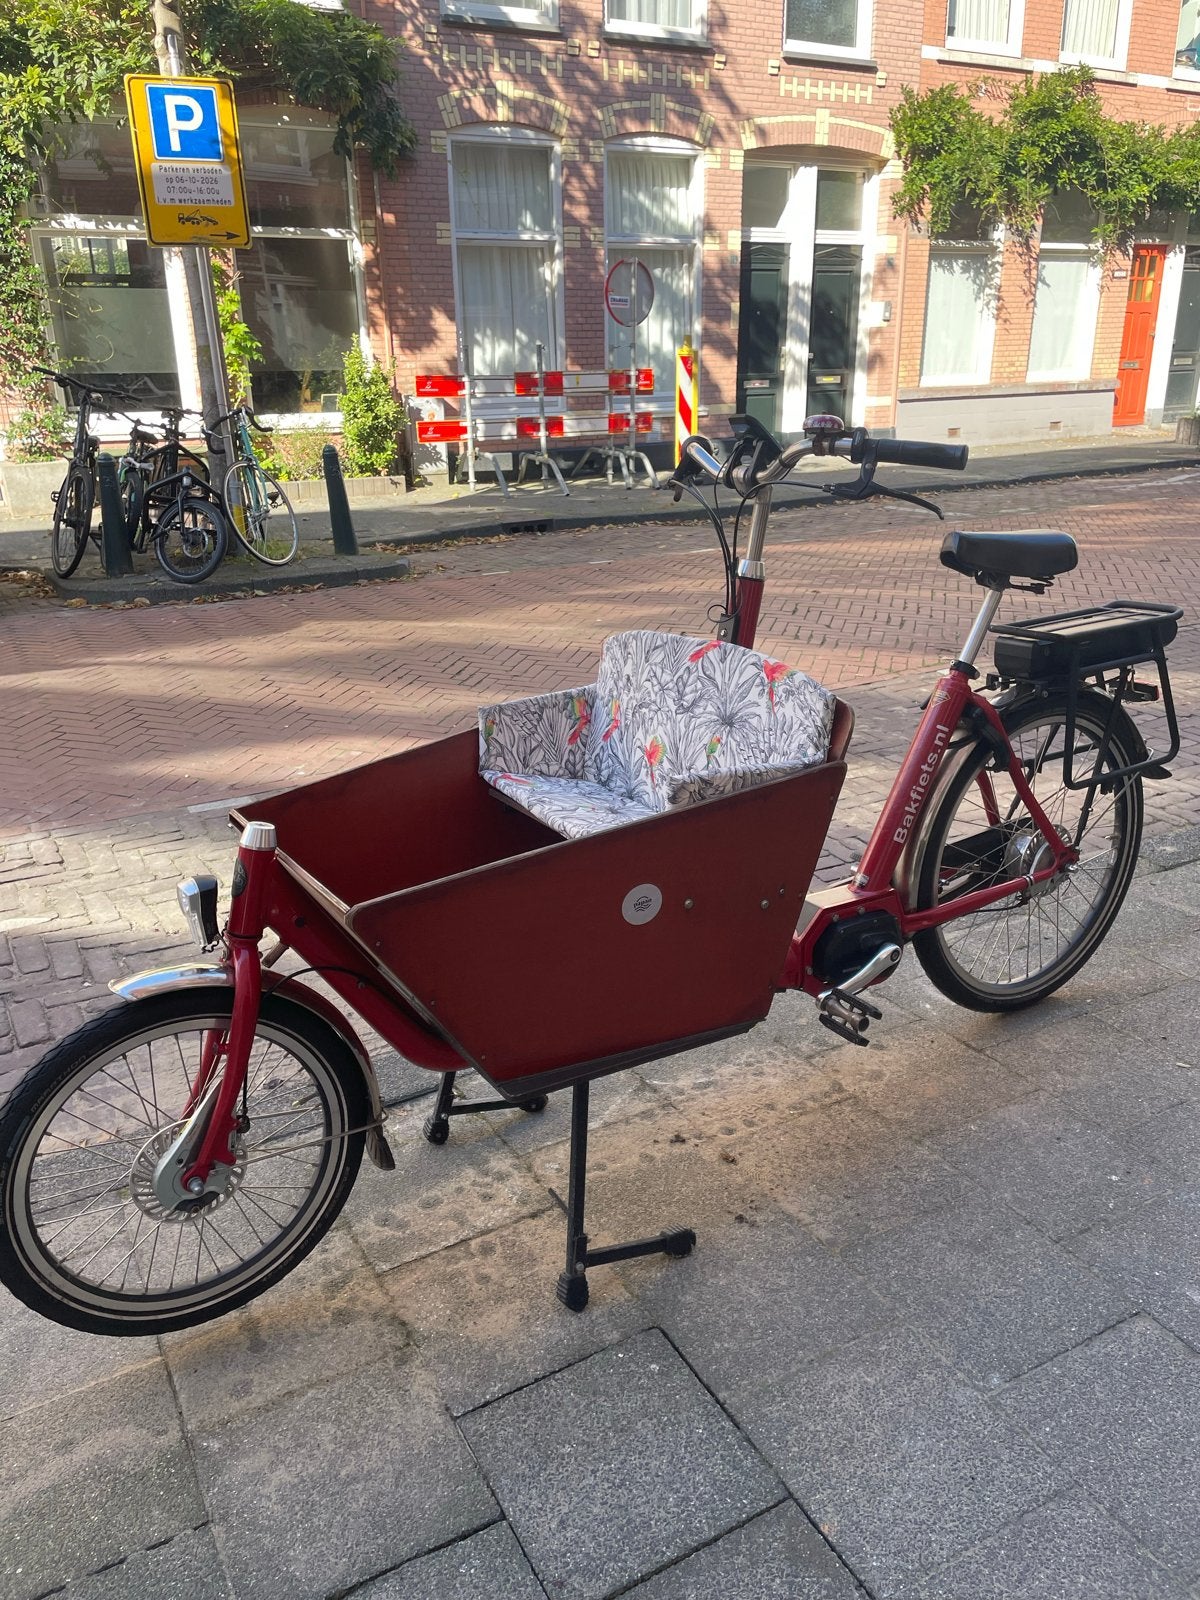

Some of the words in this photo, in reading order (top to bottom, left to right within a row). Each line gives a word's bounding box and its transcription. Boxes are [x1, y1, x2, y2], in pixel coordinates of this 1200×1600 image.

[164, 94, 204, 152] P
[159, 165, 191, 174] Parkeren
[192, 167, 223, 175] verboden
[178, 197, 232, 205] werkzaamheden
[893, 724, 950, 844] Bakfiets.nl
